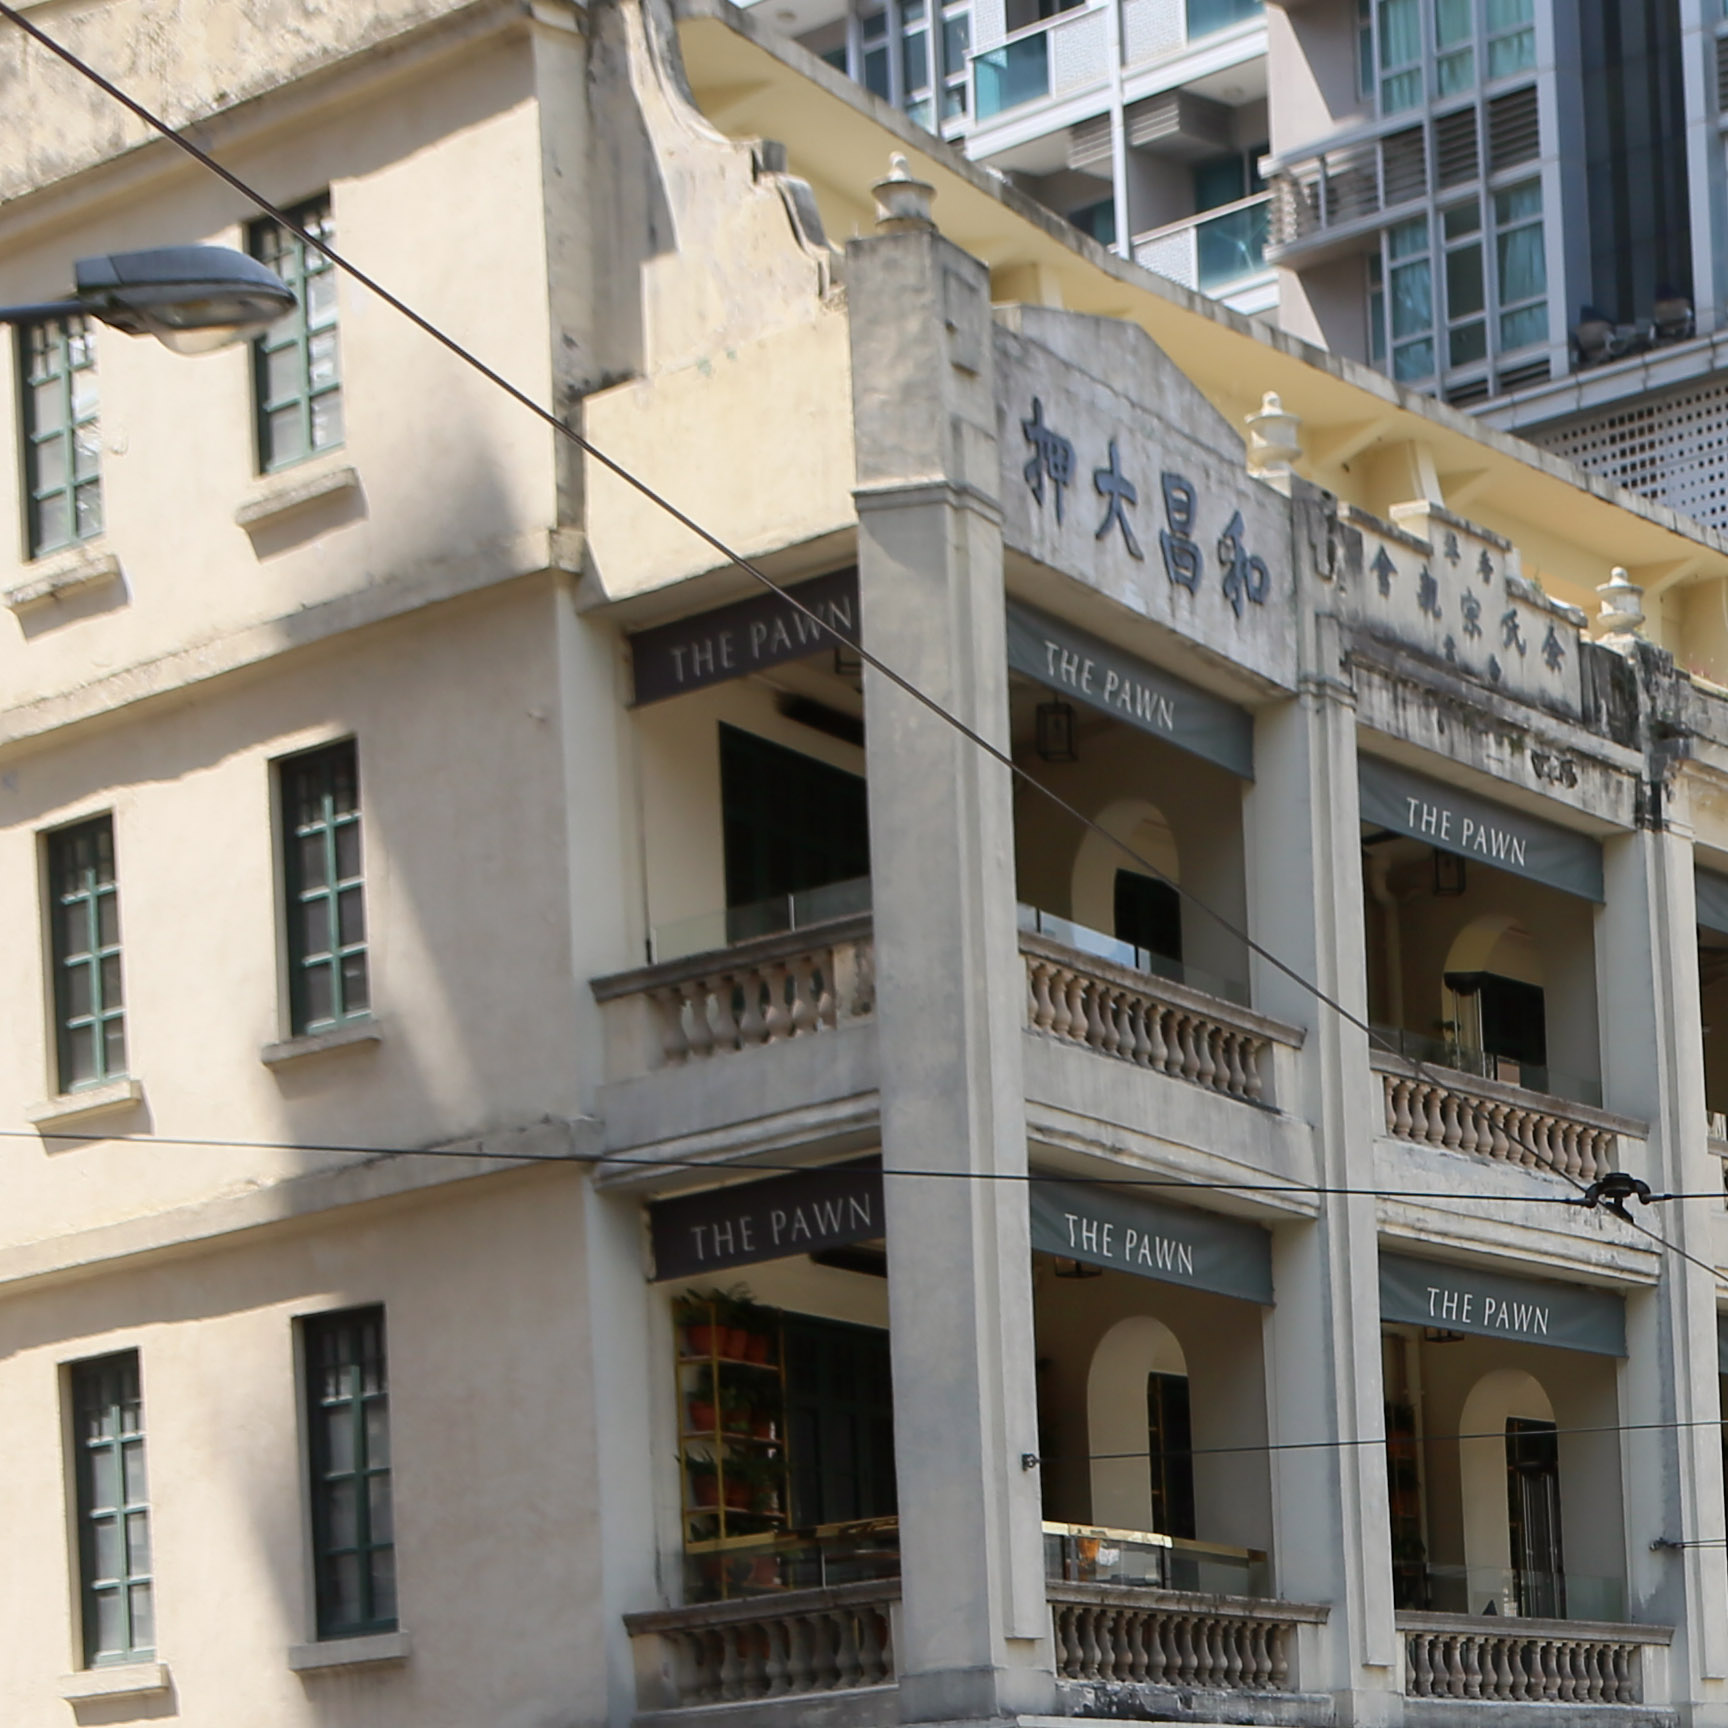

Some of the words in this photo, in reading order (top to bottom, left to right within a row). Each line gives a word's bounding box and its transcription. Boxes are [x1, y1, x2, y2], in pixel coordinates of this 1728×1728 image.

[672, 629, 734, 685] THE
[751, 597, 852, 661] PAWN
[1045, 639, 1094, 698] THE
[1105, 666, 1175, 732] PAWN
[1406, 795, 1452, 843] THE
[1462, 819, 1527, 868] PAWN
[692, 1215, 753, 1260] THE
[772, 1194, 872, 1243] PAWN
[1064, 1214, 1113, 1258] THE
[1125, 1229, 1194, 1275] PAWN
[1427, 1287, 1472, 1324] THE
[1483, 1297, 1549, 1335] PAWN
